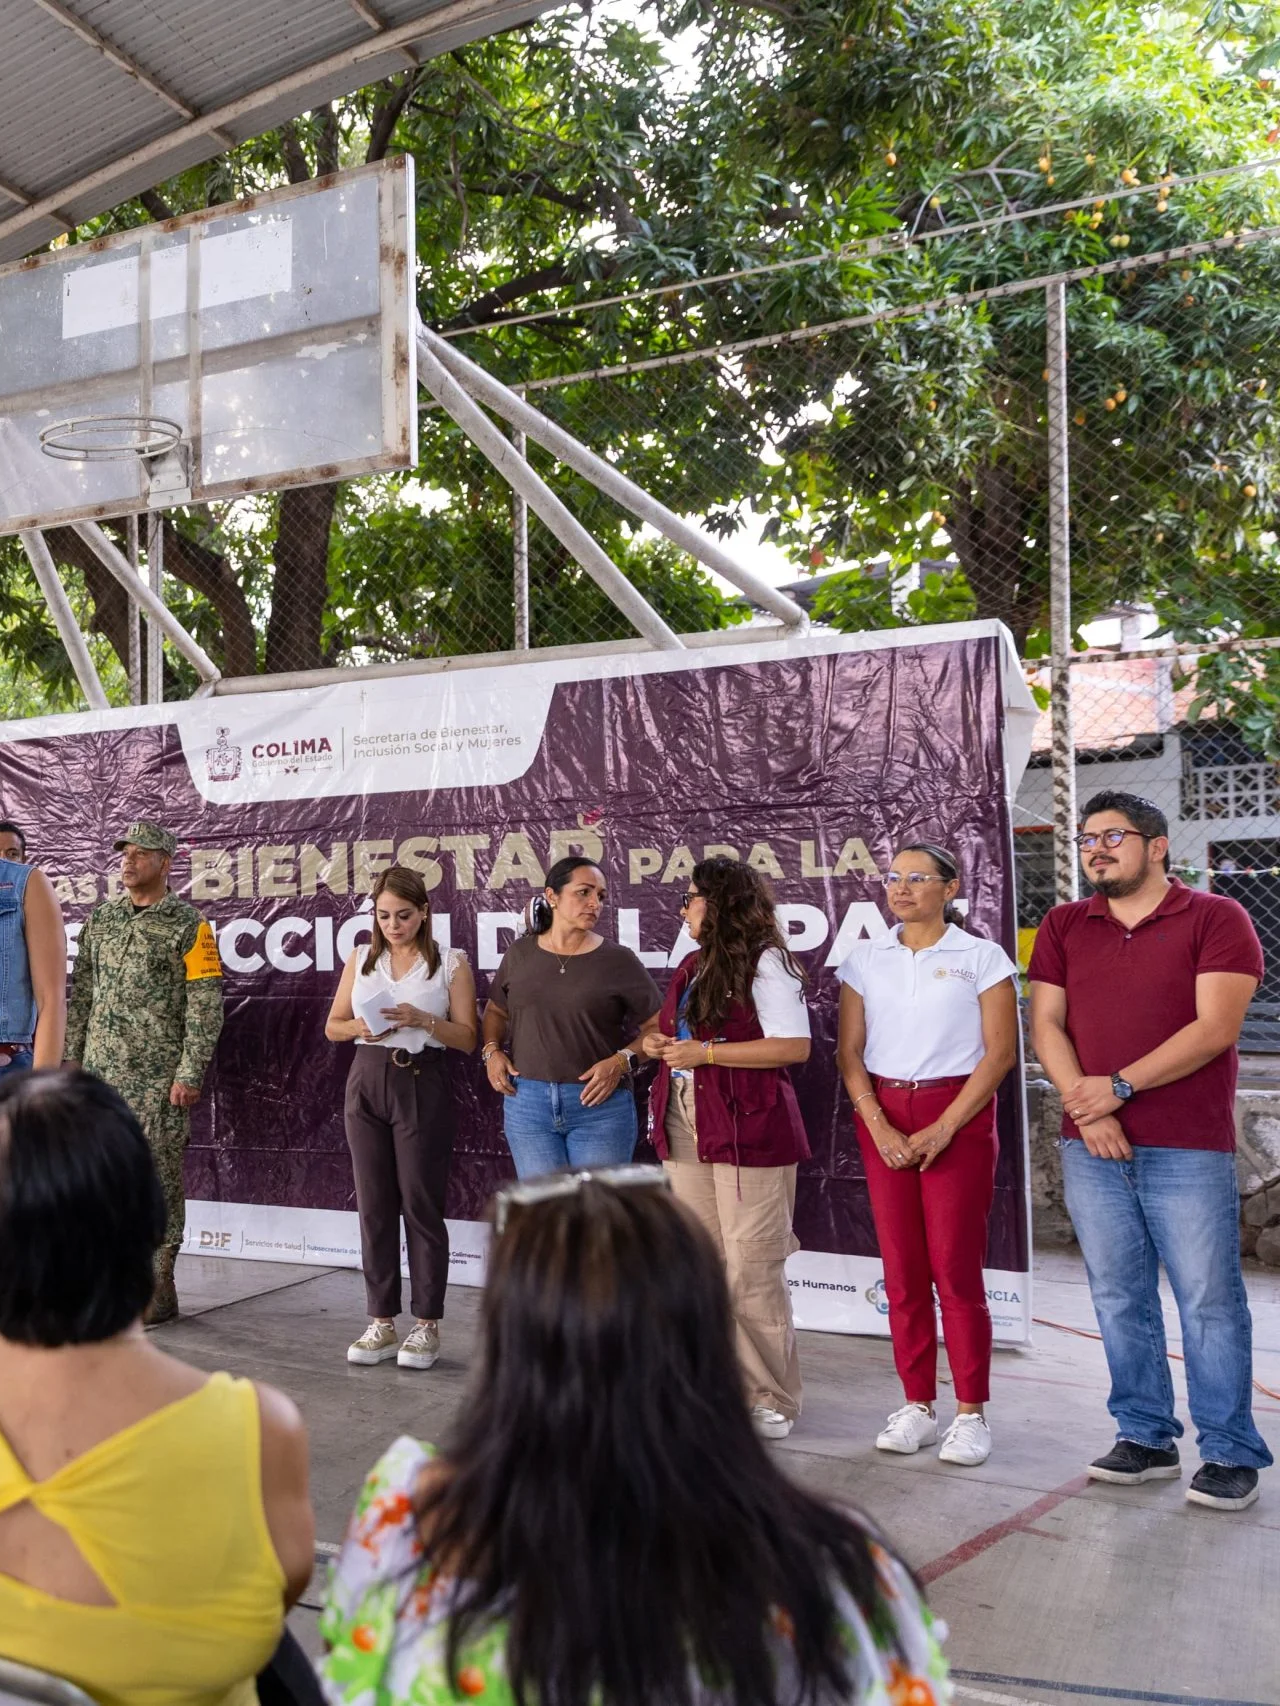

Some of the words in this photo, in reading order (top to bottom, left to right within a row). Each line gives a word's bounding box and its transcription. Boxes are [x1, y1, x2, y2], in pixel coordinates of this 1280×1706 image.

[353, 731, 417, 746] Secretaría
[420, 729, 438, 741] de
[440, 723, 508, 739] Bienestar,
[252, 737, 332, 759] COLIMA
[353, 744, 411, 759] Inclusión
[414, 740, 453, 755] Social
[456, 741, 464, 752] y
[467, 736, 522, 750] Mujeres
[290, 755, 303, 764] del
[304, 753, 333, 763] Estado
[800, 837, 884, 879] LA
[949, 968, 976, 980] SALUD
[200, 1230, 232, 1248] DIF
[245, 1238, 272, 1248] Servicios
[274, 1241, 283, 1249] de
[284, 1242, 302, 1251] Salud
[802, 1279, 857, 1293] Humanos
